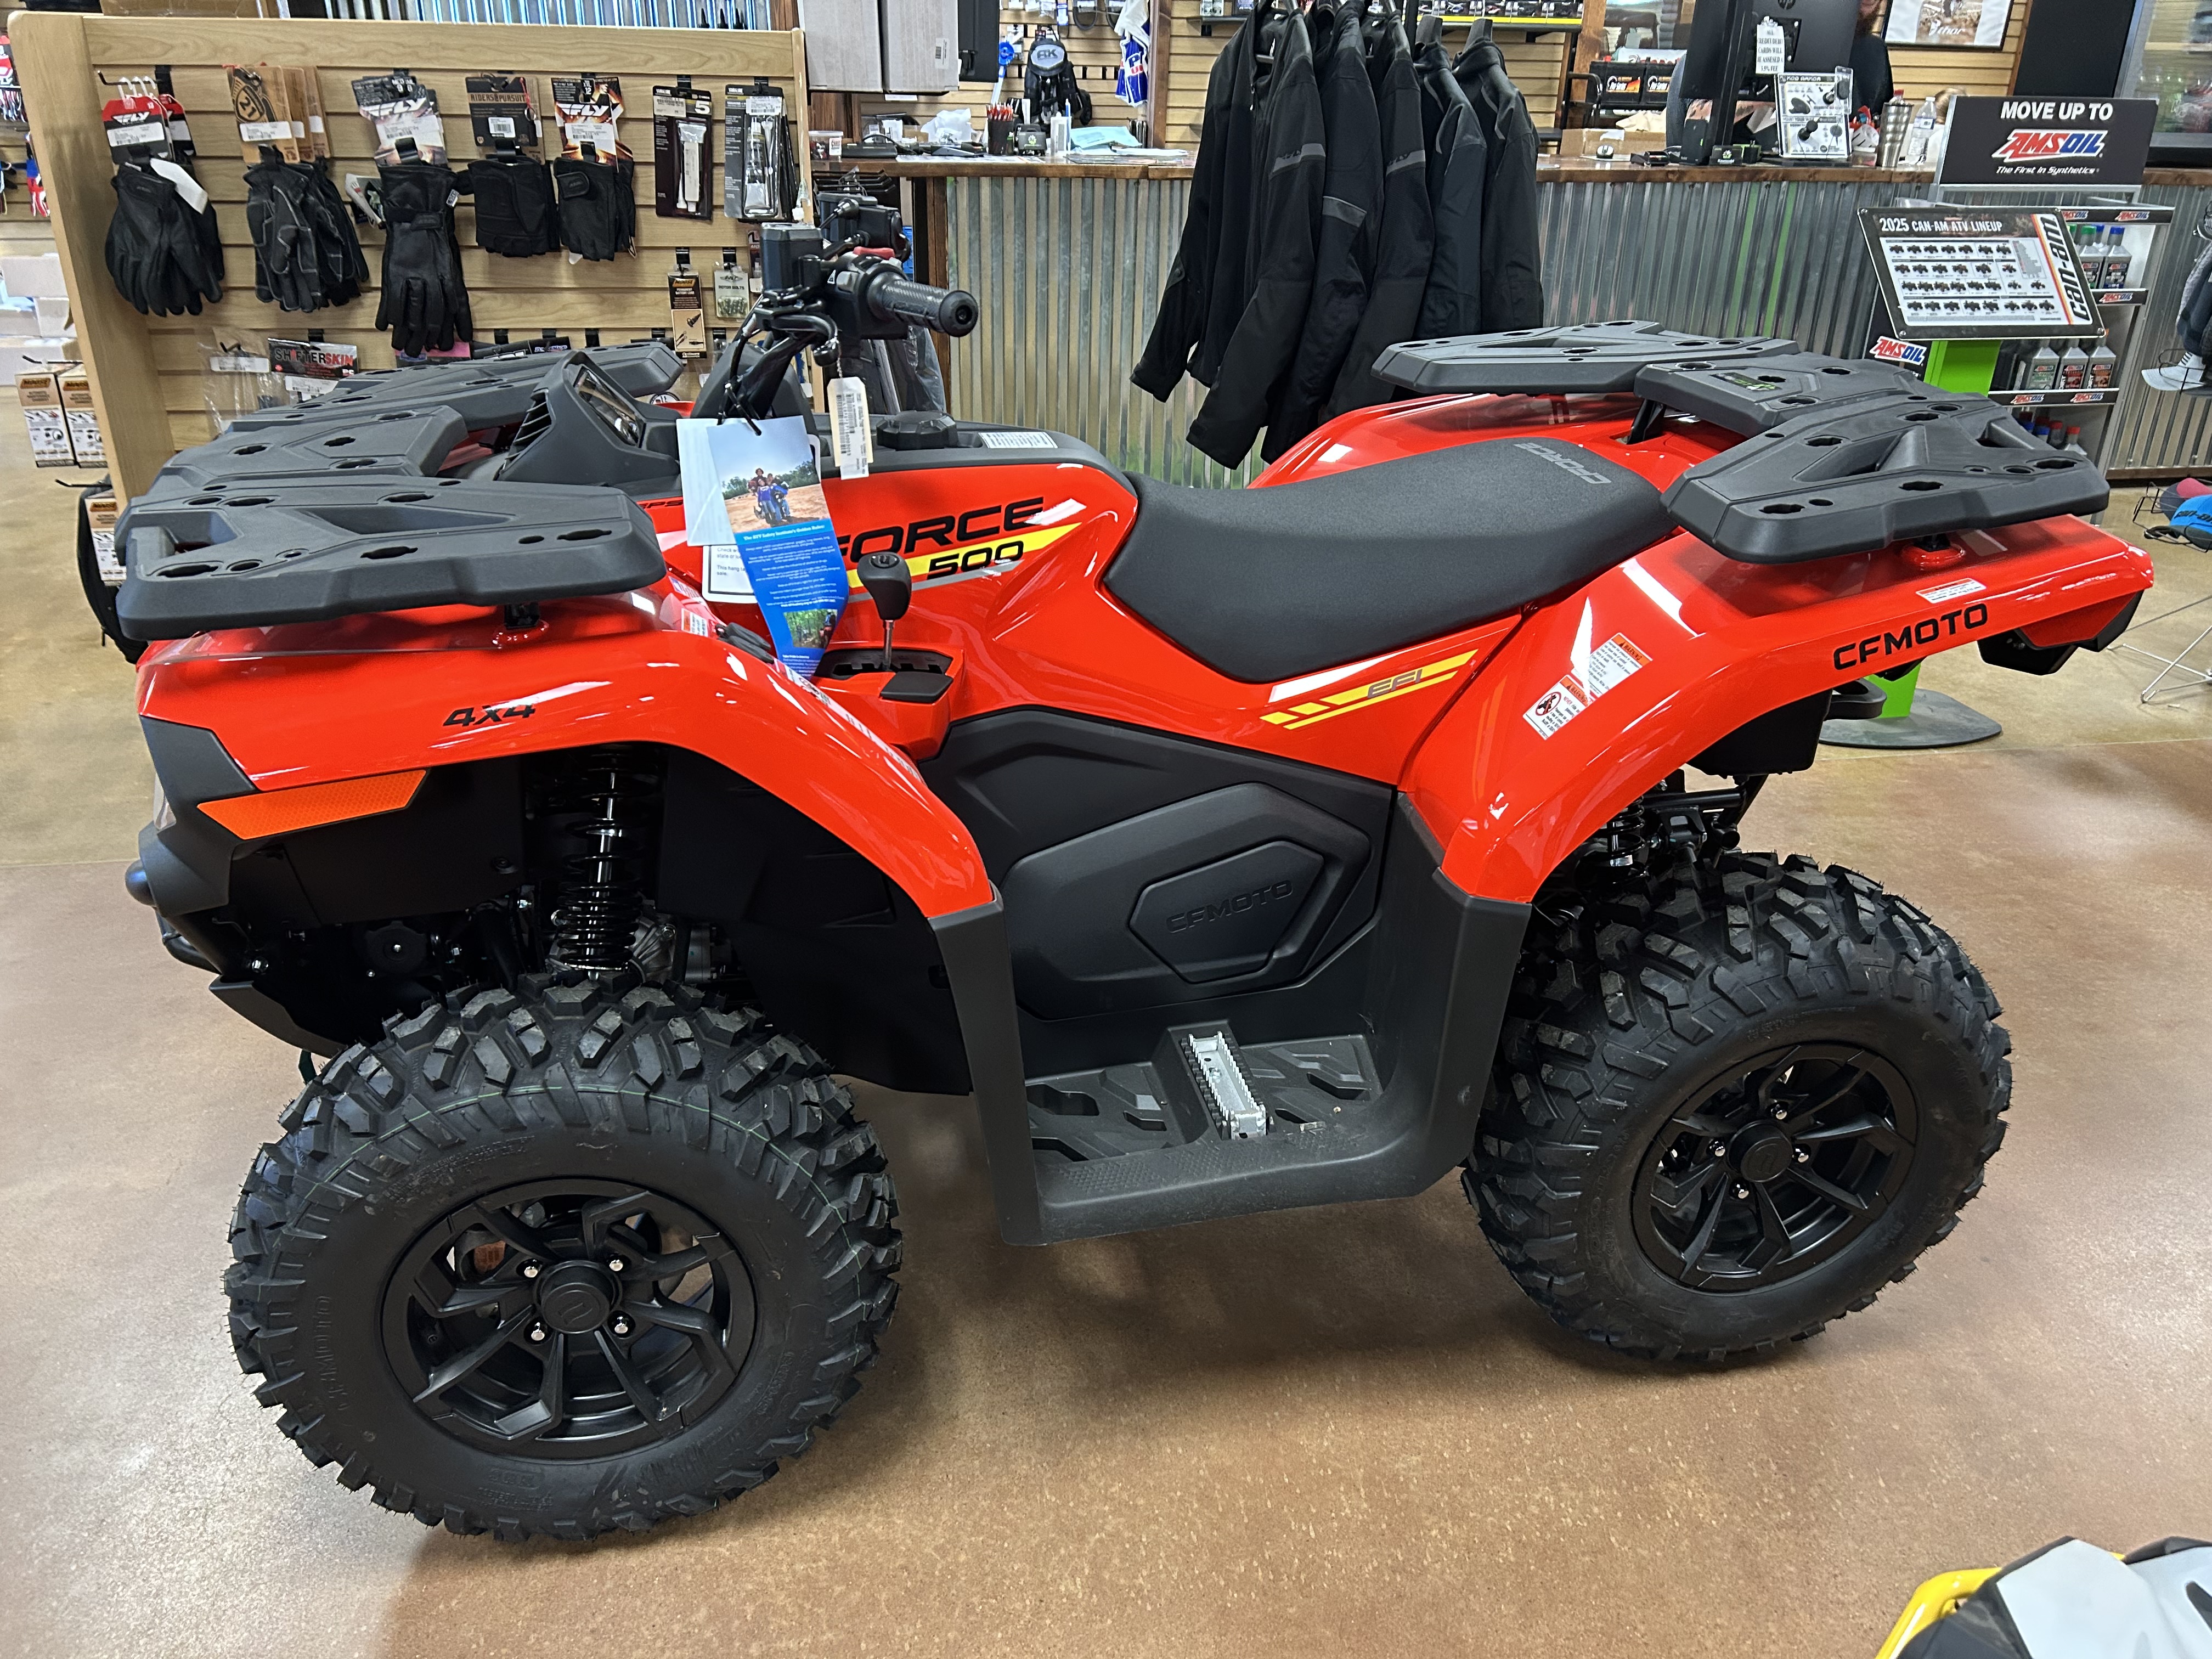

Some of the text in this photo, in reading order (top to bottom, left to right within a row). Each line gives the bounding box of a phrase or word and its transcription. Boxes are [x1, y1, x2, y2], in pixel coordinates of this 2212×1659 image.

[556, 103, 610, 117] FLY
[695, 100, 710, 114] 5
[2000, 101, 2113, 120] MOVE UP TO
[112, 111, 151, 123] FLY
[1997, 131, 2106, 160] AMSOIL
[2047, 167, 2096, 176] Synthetics
[2117, 211, 2149, 221] AMSOIL
[1879, 218, 2002, 232] 2025 CAN-AM ATV LINEUP
[2040, 216, 2091, 321] can-am
[2101, 294, 2133, 303] AMSOIL
[1872, 337, 1925, 363] AMSOIL
[2012, 394, 2045, 404] AMSOIL
[2072, 393, 2104, 403] AMSOIL
[1513, 437, 1612, 484] CFORCE
[2174, 510, 2212, 526] can-a
[837, 497, 1043, 563] FORCE
[928, 540, 1024, 579] 500
[1833, 603, 1988, 671] CFMOTO
[1624, 644, 1642, 661] WARNING
[1366, 669, 1423, 698] EFI
[1166, 880, 1293, 933] CFMOTO
